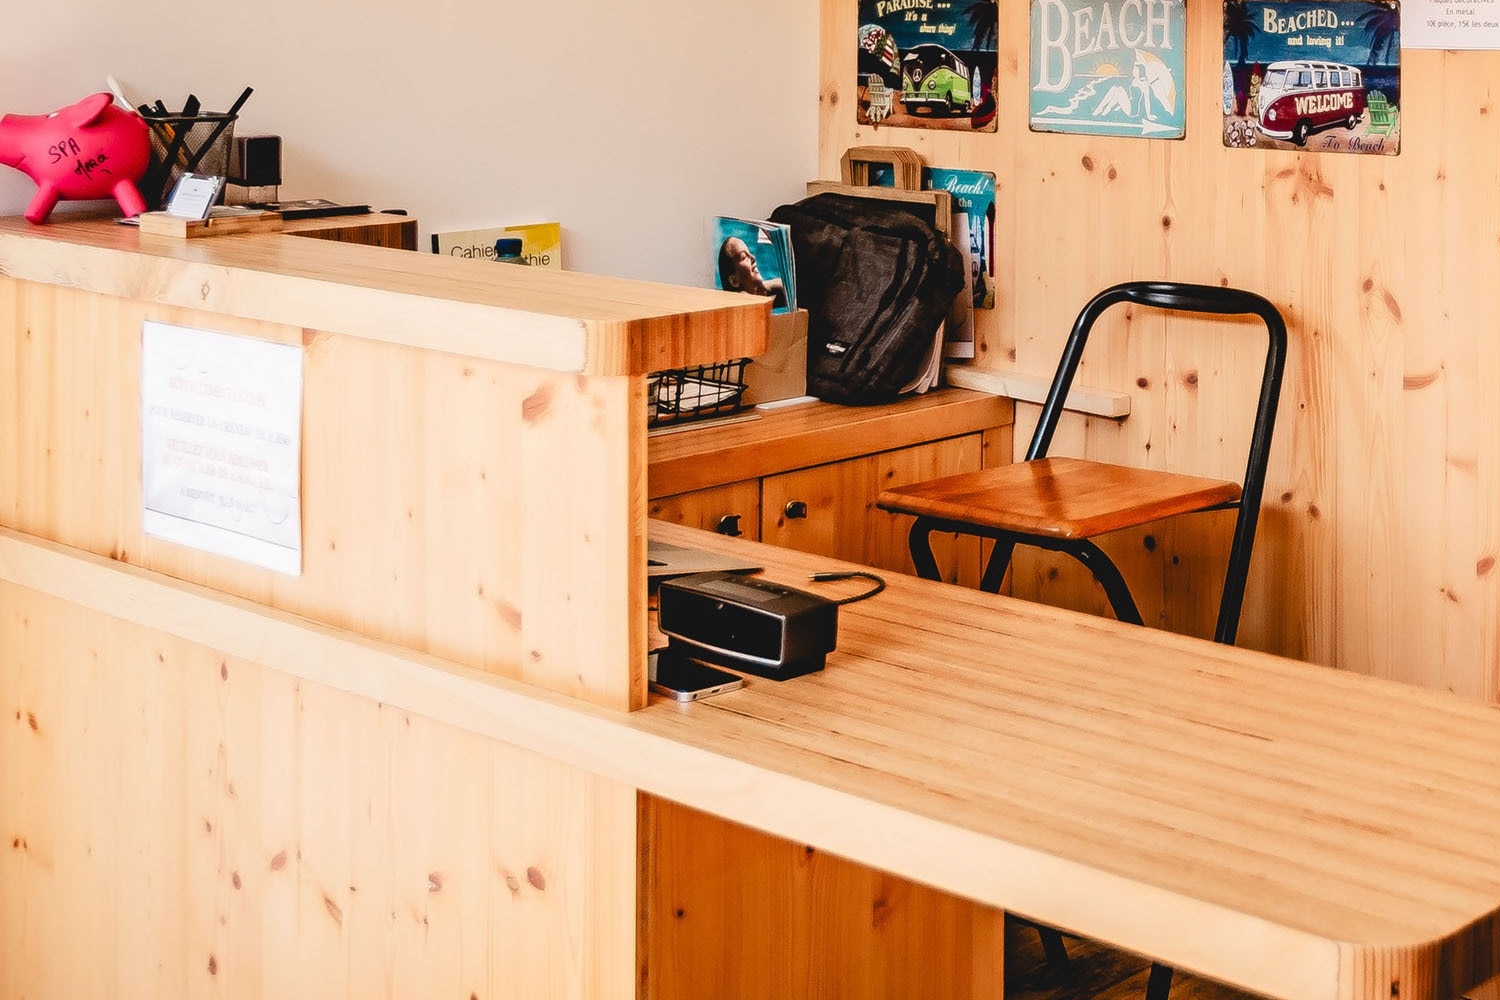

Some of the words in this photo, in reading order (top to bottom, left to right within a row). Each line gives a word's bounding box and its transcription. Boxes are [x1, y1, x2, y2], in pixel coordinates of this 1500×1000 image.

[904, 11, 917, 21] it's
[1426, 20, 1436, 28] 10€
[1459, 20, 1470, 28] 15€
[1471, 20, 1481, 28] les
[1483, 20, 1499, 28] deux
[1287, 35, 1303, 46] and
[1306, 35, 1332, 47] loving
[1335, 35, 1344, 46] it!
[1294, 92, 1354, 116] WELCOME
[48, 138, 81, 165] SPA
[945, 174, 989, 195] Beach!
